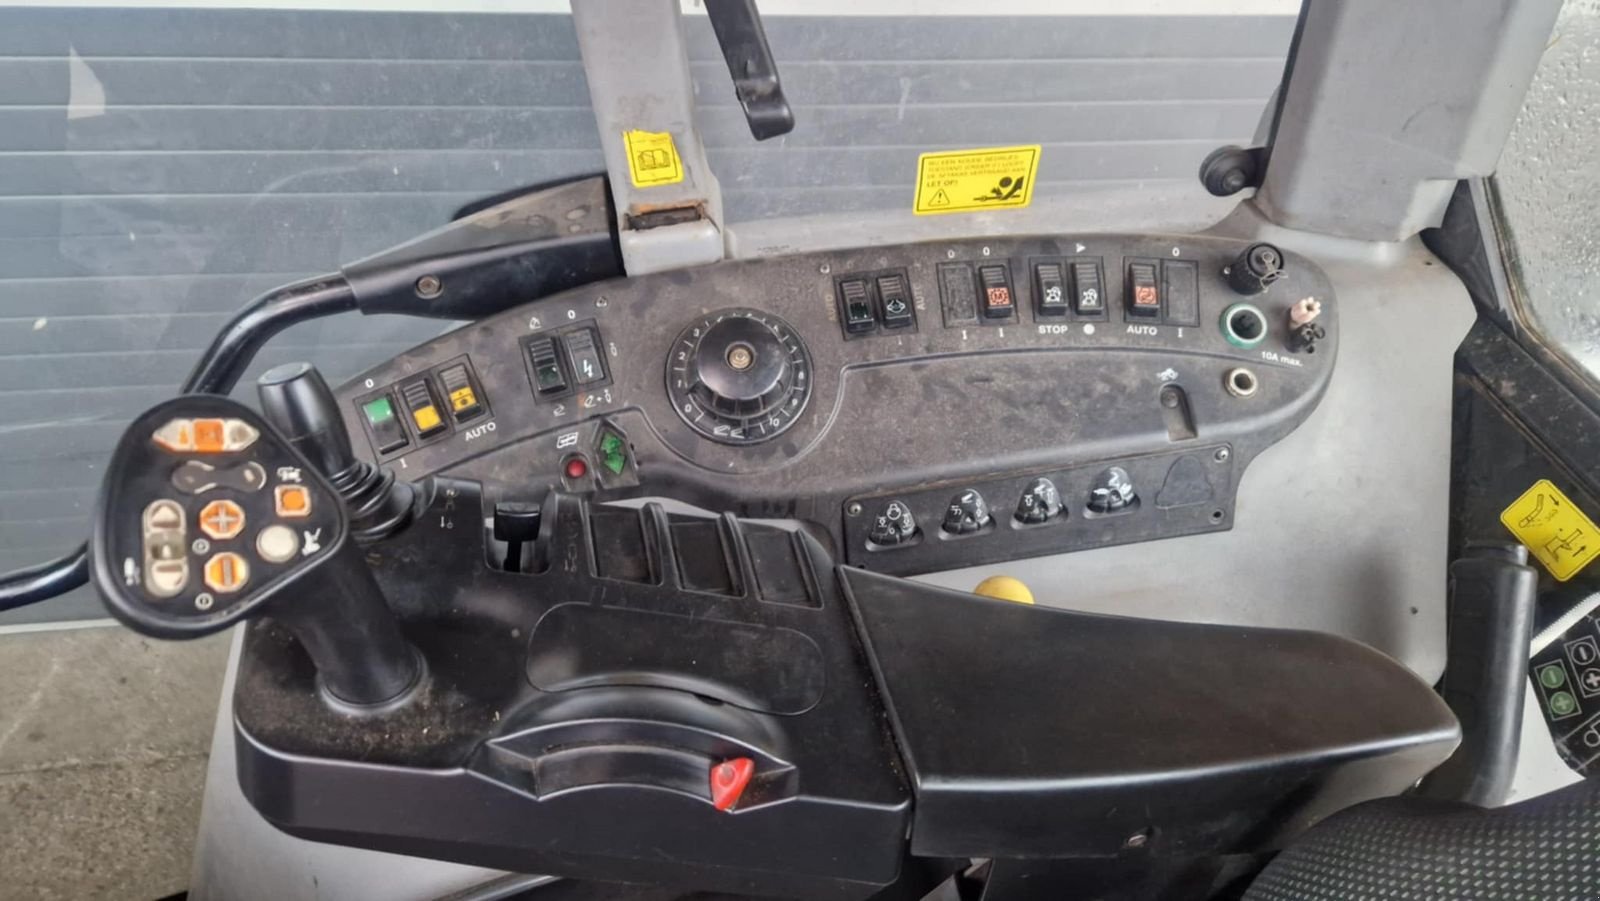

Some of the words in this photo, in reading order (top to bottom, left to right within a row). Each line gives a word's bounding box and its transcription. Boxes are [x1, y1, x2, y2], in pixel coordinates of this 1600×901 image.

[926, 179, 942, 188] LET
[1038, 325, 1068, 335] STOP
[1126, 324, 1158, 337] AUTO
[678, 351, 686, 361] 2
[1261, 350, 1279, 363] 10A
[1280, 354, 1304, 367] max.
[769, 417, 780, 428] 10
[464, 421, 497, 442] AUTO
